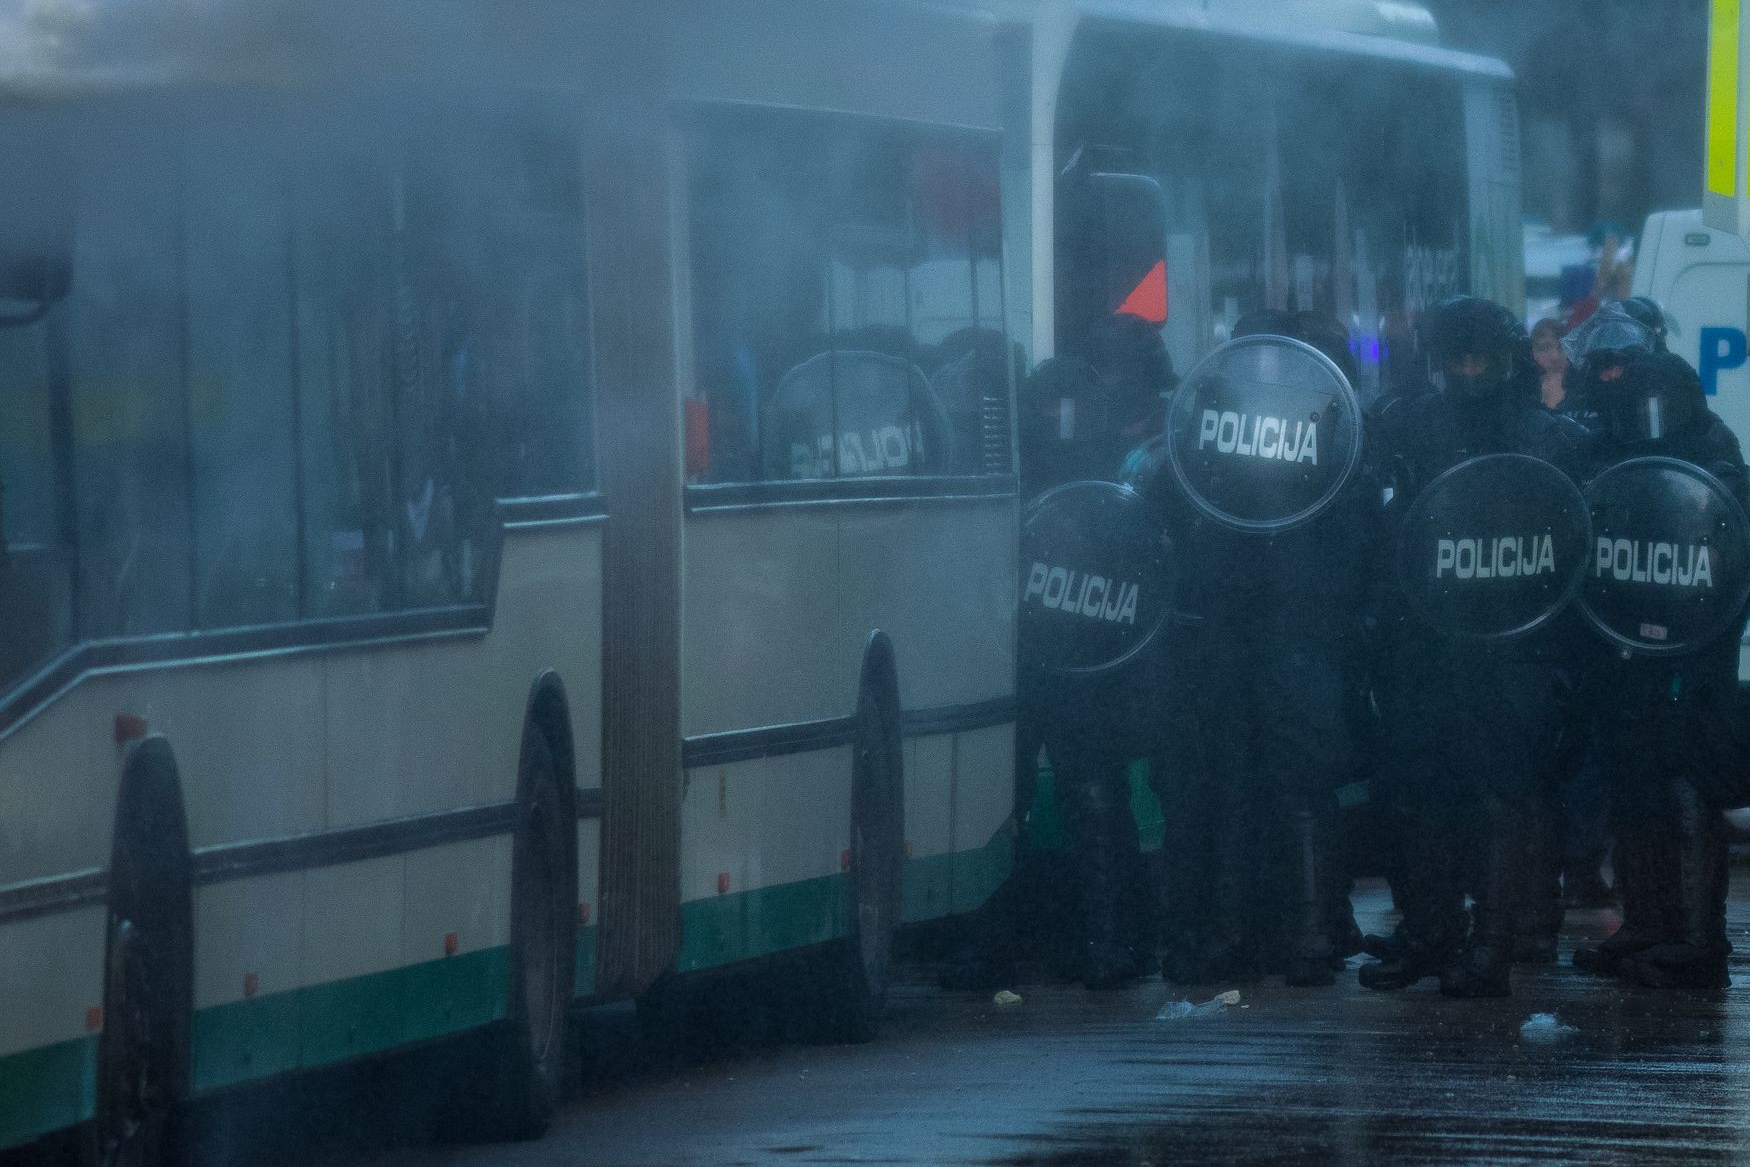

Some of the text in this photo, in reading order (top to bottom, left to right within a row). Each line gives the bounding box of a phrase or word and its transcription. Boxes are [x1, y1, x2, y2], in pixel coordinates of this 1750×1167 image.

[1198, 409, 1318, 466] POLICIJA
[1436, 534, 1556, 578] POLICIJA
[1597, 536, 1713, 587] POLICIJA
[1023, 562, 1139, 625] POLICIJA
